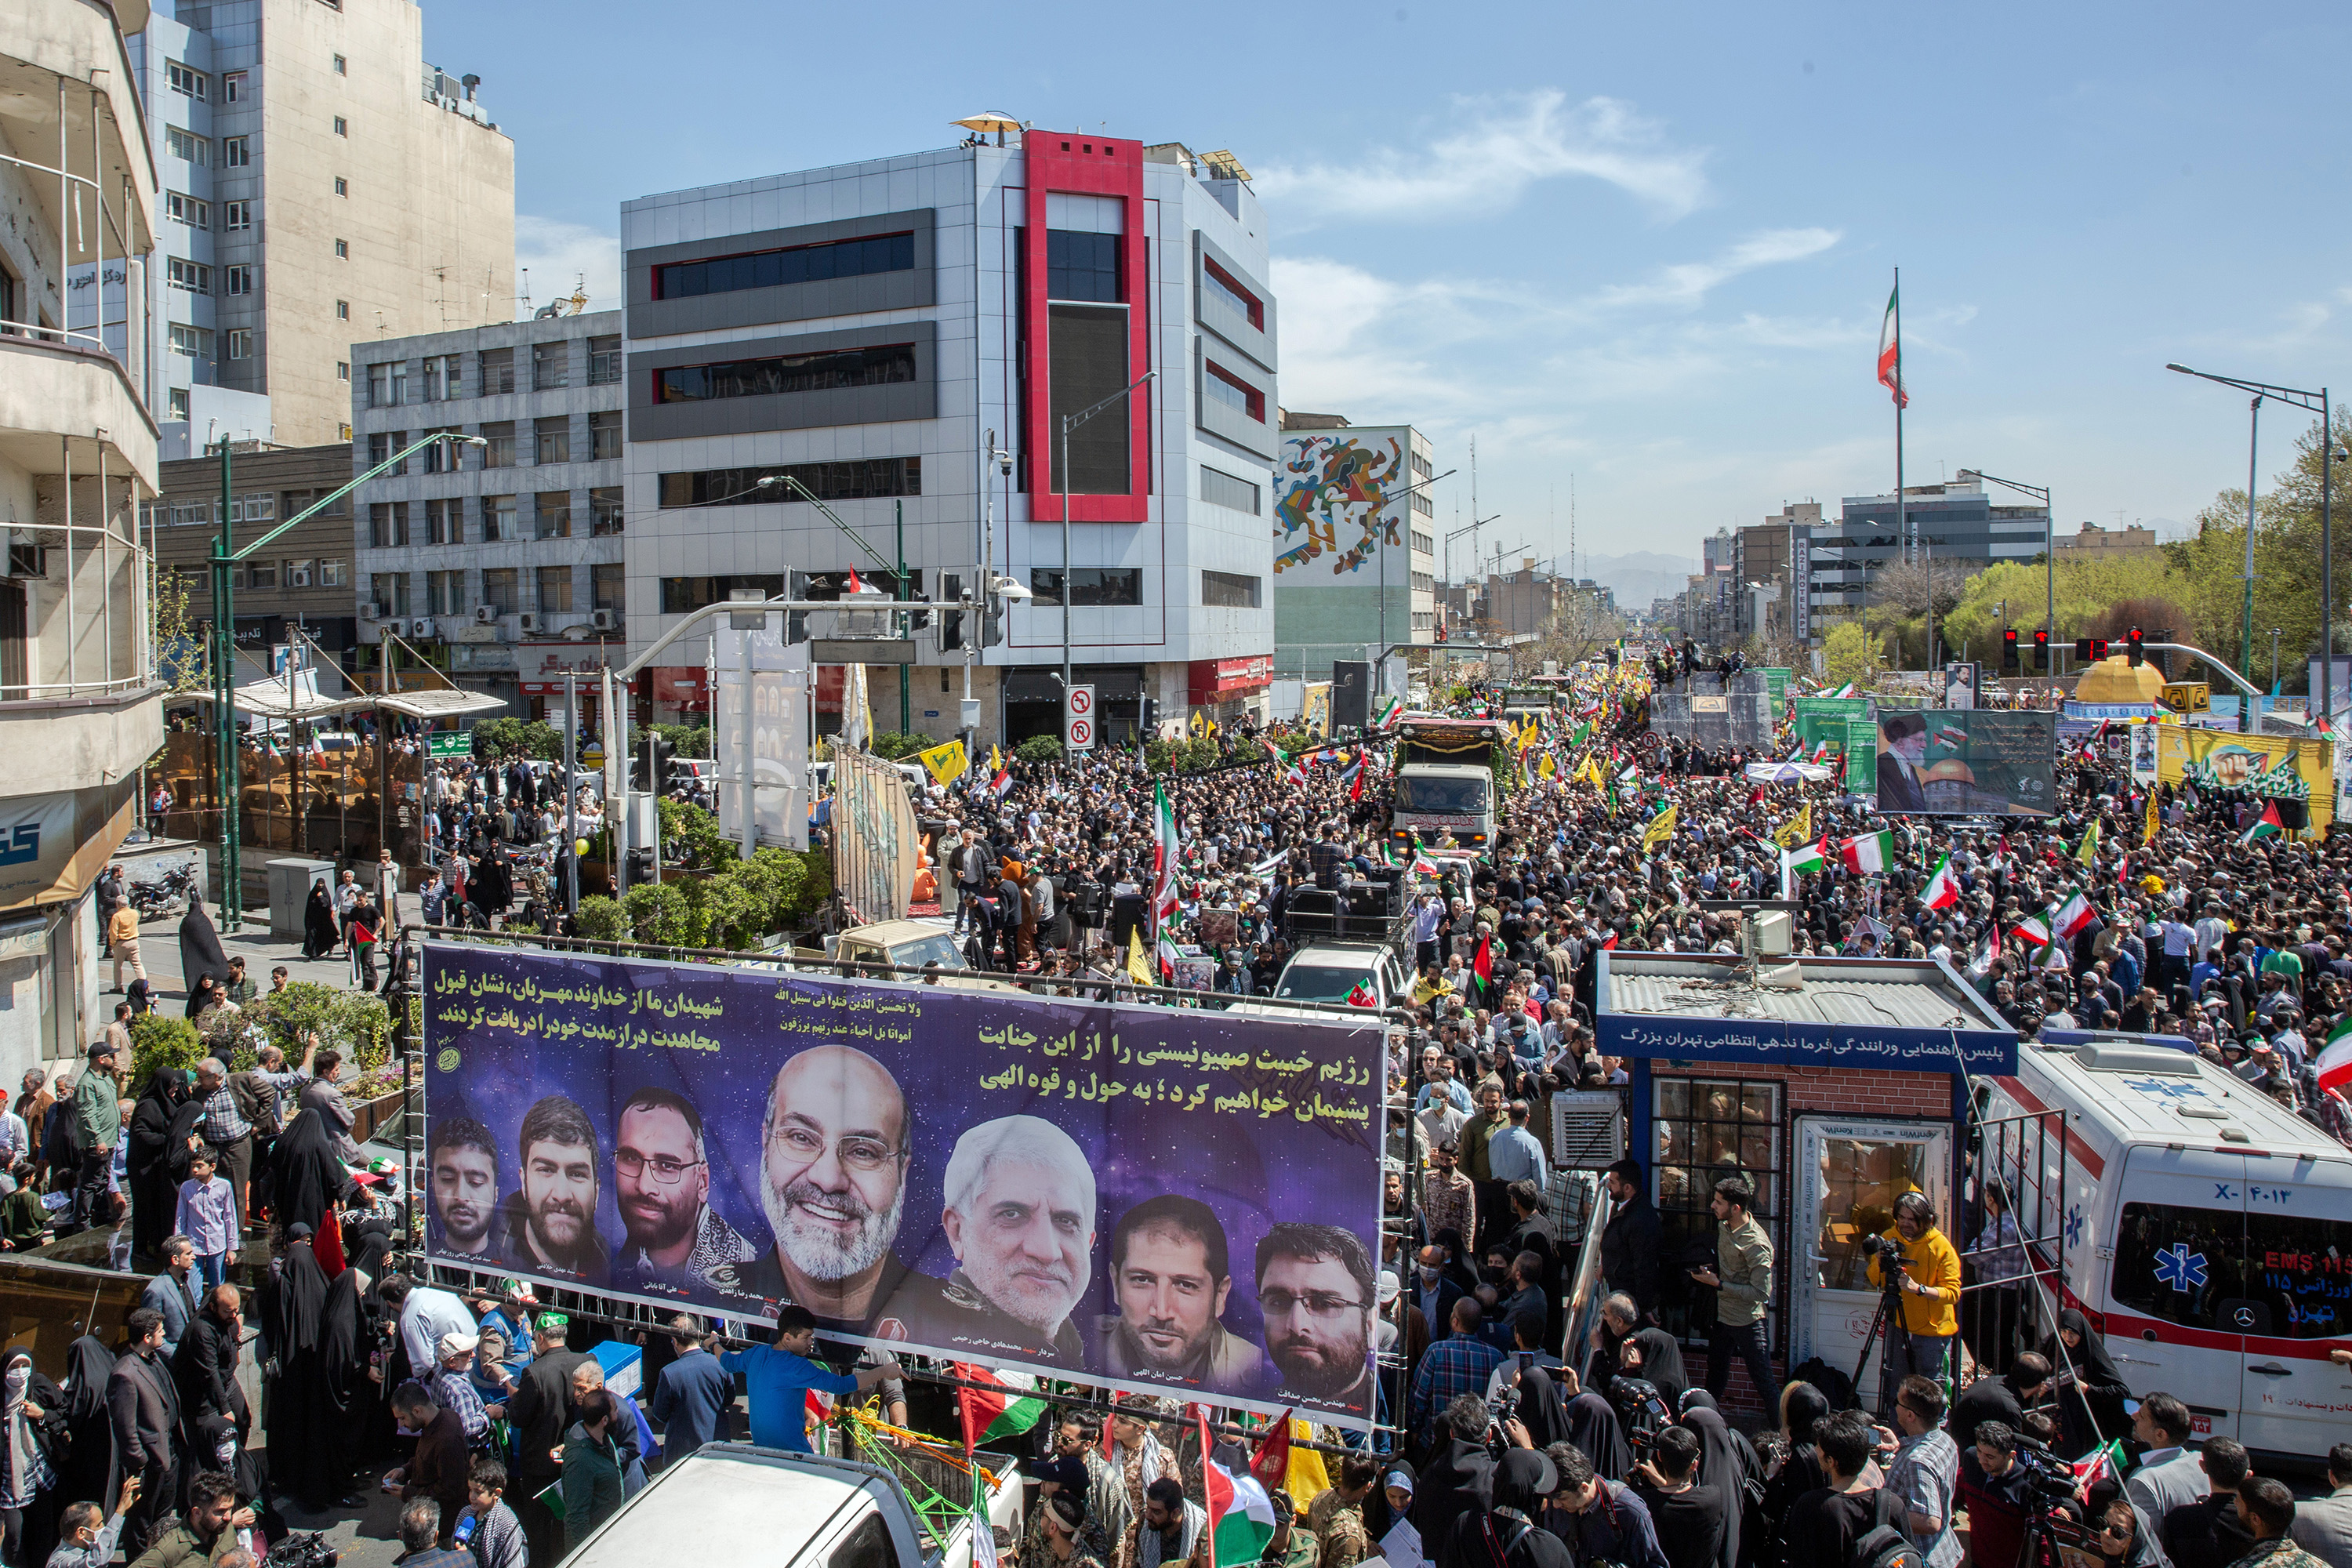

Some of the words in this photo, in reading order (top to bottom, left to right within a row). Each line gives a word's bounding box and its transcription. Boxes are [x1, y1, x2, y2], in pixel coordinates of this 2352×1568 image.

[2089, 640, 2108, 661] 13
[574, 985, 627, 1010] خداوند
[628, 989, 643, 1014] از
[646, 989, 662, 1011] ما
[663, 993, 724, 1018] شهیدان
[486, 1009, 537, 1036] دریافت
[978, 1023, 1038, 1054] جنایت
[1043, 1030, 1076, 1057] این
[1080, 1033, 1101, 1061] از
[1621, 1028, 1663, 1045] بزرگ
[1665, 1032, 1704, 1048] تهران
[1704, 1033, 1756, 1049] انتظامی
[1112, 1034, 1131, 1065] را
[1137, 1040, 1250, 1072] صهیونیستی
[1902, 1042, 1963, 1059] راهنمایی
[1963, 1045, 2004, 1063] پلیس
[1255, 1049, 1314, 1078] خبیث
[1320, 1055, 1370, 1087] رژیم
[979, 1063, 1025, 1090] الهی
[1027, 1066, 1062, 1097] قوه
[1064, 1080, 1077, 1099] و
[1080, 1072, 1128, 1103] حول
[1131, 1082, 1152, 1106] به
[1214, 1087, 1290, 1119] خواهیم
[1294, 1094, 1370, 1130] پشیمان
[1805, 1175, 1813, 1209] KentWin
[2250, 1185, 2292, 1204] ۴۰۱۳
[454, 1250, 470, 1259] صالحی
[2265, 1251, 2314, 1272] EMS
[553, 1265, 567, 1275] مهدی
[2265, 1272, 2292, 1290] ۱۱۵
[719, 1287, 738, 1297] زاهدی
[748, 1292, 764, 1301] محمد
[764, 1295, 778, 1304] شهید
[2288, 1304, 2336, 1325] تهران
[952, 1335, 972, 1345] رحیمی
[972, 1338, 990, 1346] حاجی
[1037, 1348, 1055, 1358] سردار
[1133, 1368, 1150, 1377] اللهی
[1150, 1370, 1165, 1379] امان
[1277, 1389, 1301, 1399] صداقت
[1301, 1395, 1322, 1404] محسن
[1322, 1399, 1346, 1409] مهندس
[1347, 1403, 1363, 1411] شهید
[1482, 1515, 1491, 1536] Canon
